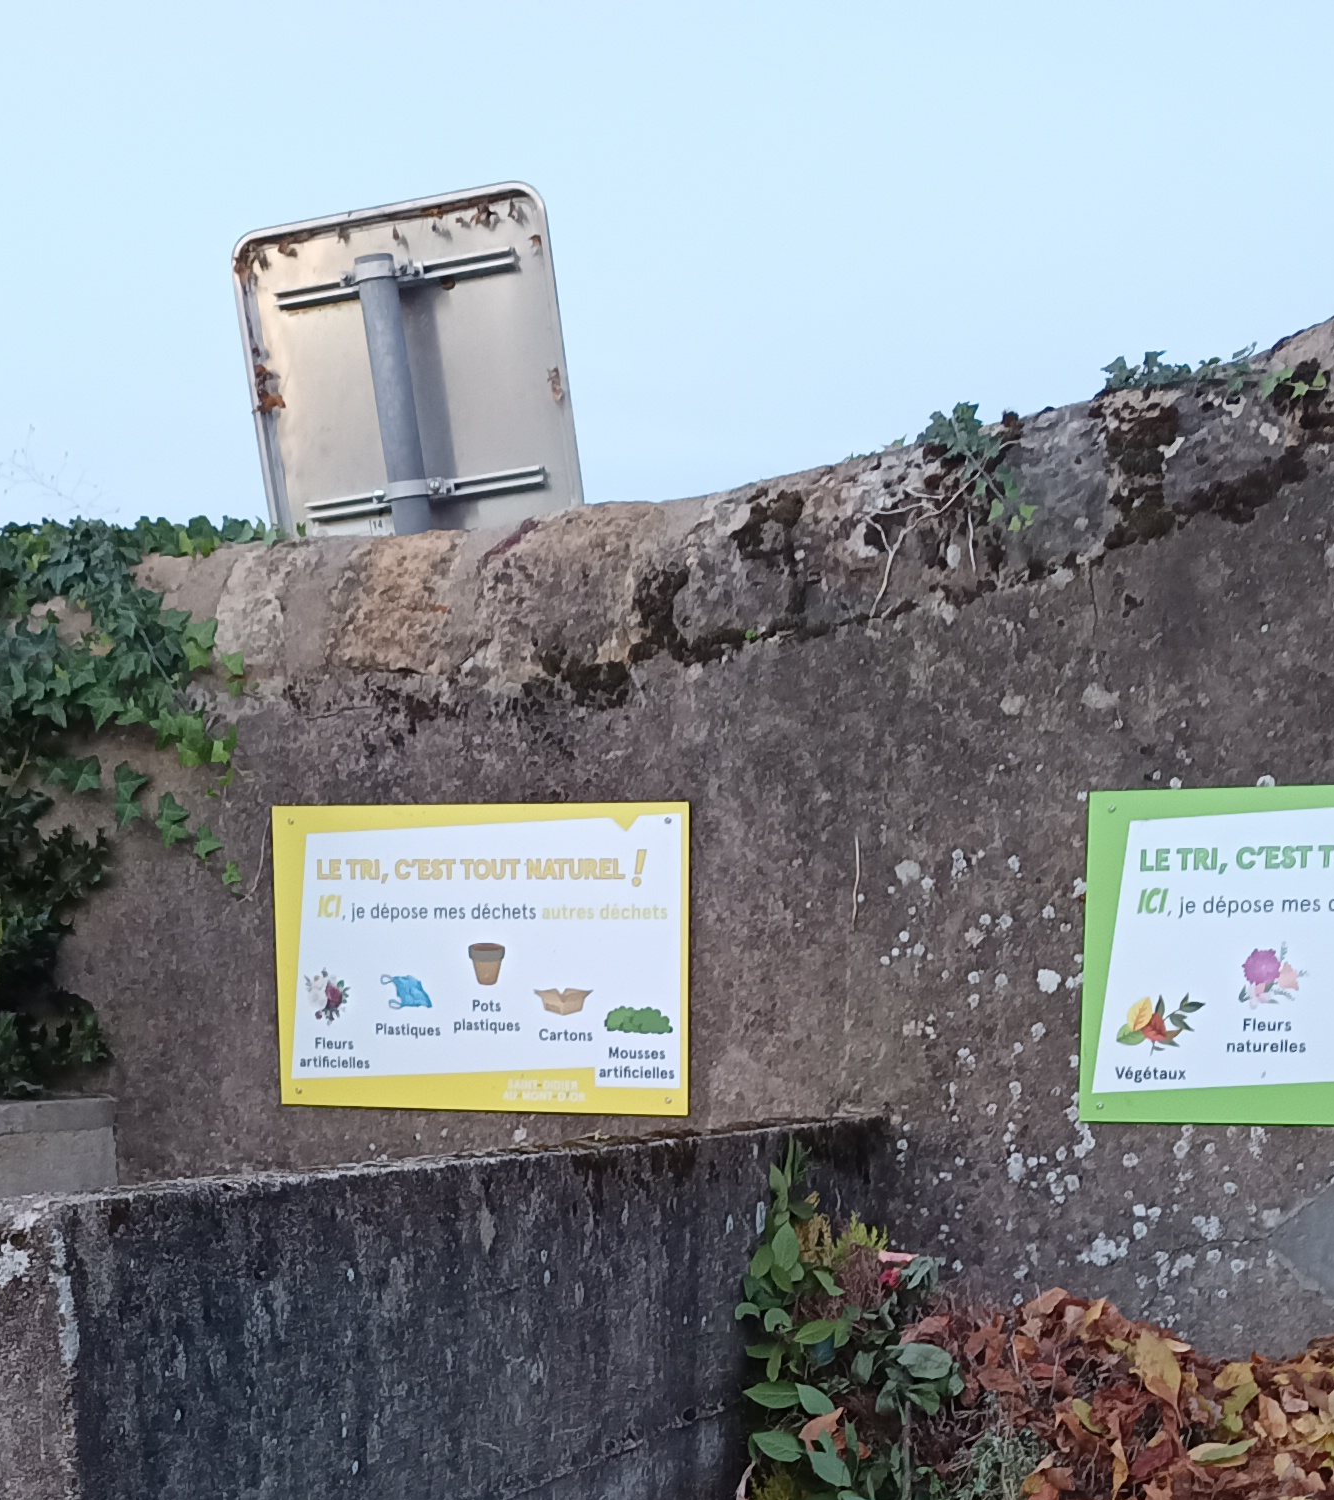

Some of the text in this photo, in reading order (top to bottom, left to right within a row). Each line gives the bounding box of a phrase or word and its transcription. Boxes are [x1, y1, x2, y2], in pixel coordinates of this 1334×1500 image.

[1139, 848, 1170, 872] LE
[1176, 847, 1228, 874] TRI,
[1235, 845, 1313, 869] C'EST
[316, 858, 342, 881] LE
[346, 858, 389, 884] TRI,
[394, 858, 456, 881] C'EST
[460, 858, 521, 881] TOUT
[525, 858, 626, 881] NATUREL
[1136, 887, 1173, 917] ICI,
[1178, 895, 1196, 918] je
[1202, 893, 1274, 918] dépose
[1281, 896, 1321, 914] mes
[350, 902, 366, 923] je
[370, 902, 429, 924] dépose
[433, 905, 466, 920] mes
[470, 902, 537, 921] déchets
[541, 904, 595, 920] autres
[599, 902, 668, 921] déchets
[471, 999, 502, 1012] Pots
[375, 1022, 442, 1039] Plastiques
[453, 1018, 521, 1034] plastiques
[1242, 1017, 1293, 1032] Fleurs
[538, 1028, 594, 1042] Cartons
[314, 1037, 354, 1051] Fleurs
[1225, 1039, 1307, 1054] naturelles
[608, 1046, 666, 1060] Mousses
[299, 1055, 371, 1070] artificielles
[598, 1066, 675, 1080] artificielles
[1114, 1065, 1187, 1083] Végétaux
